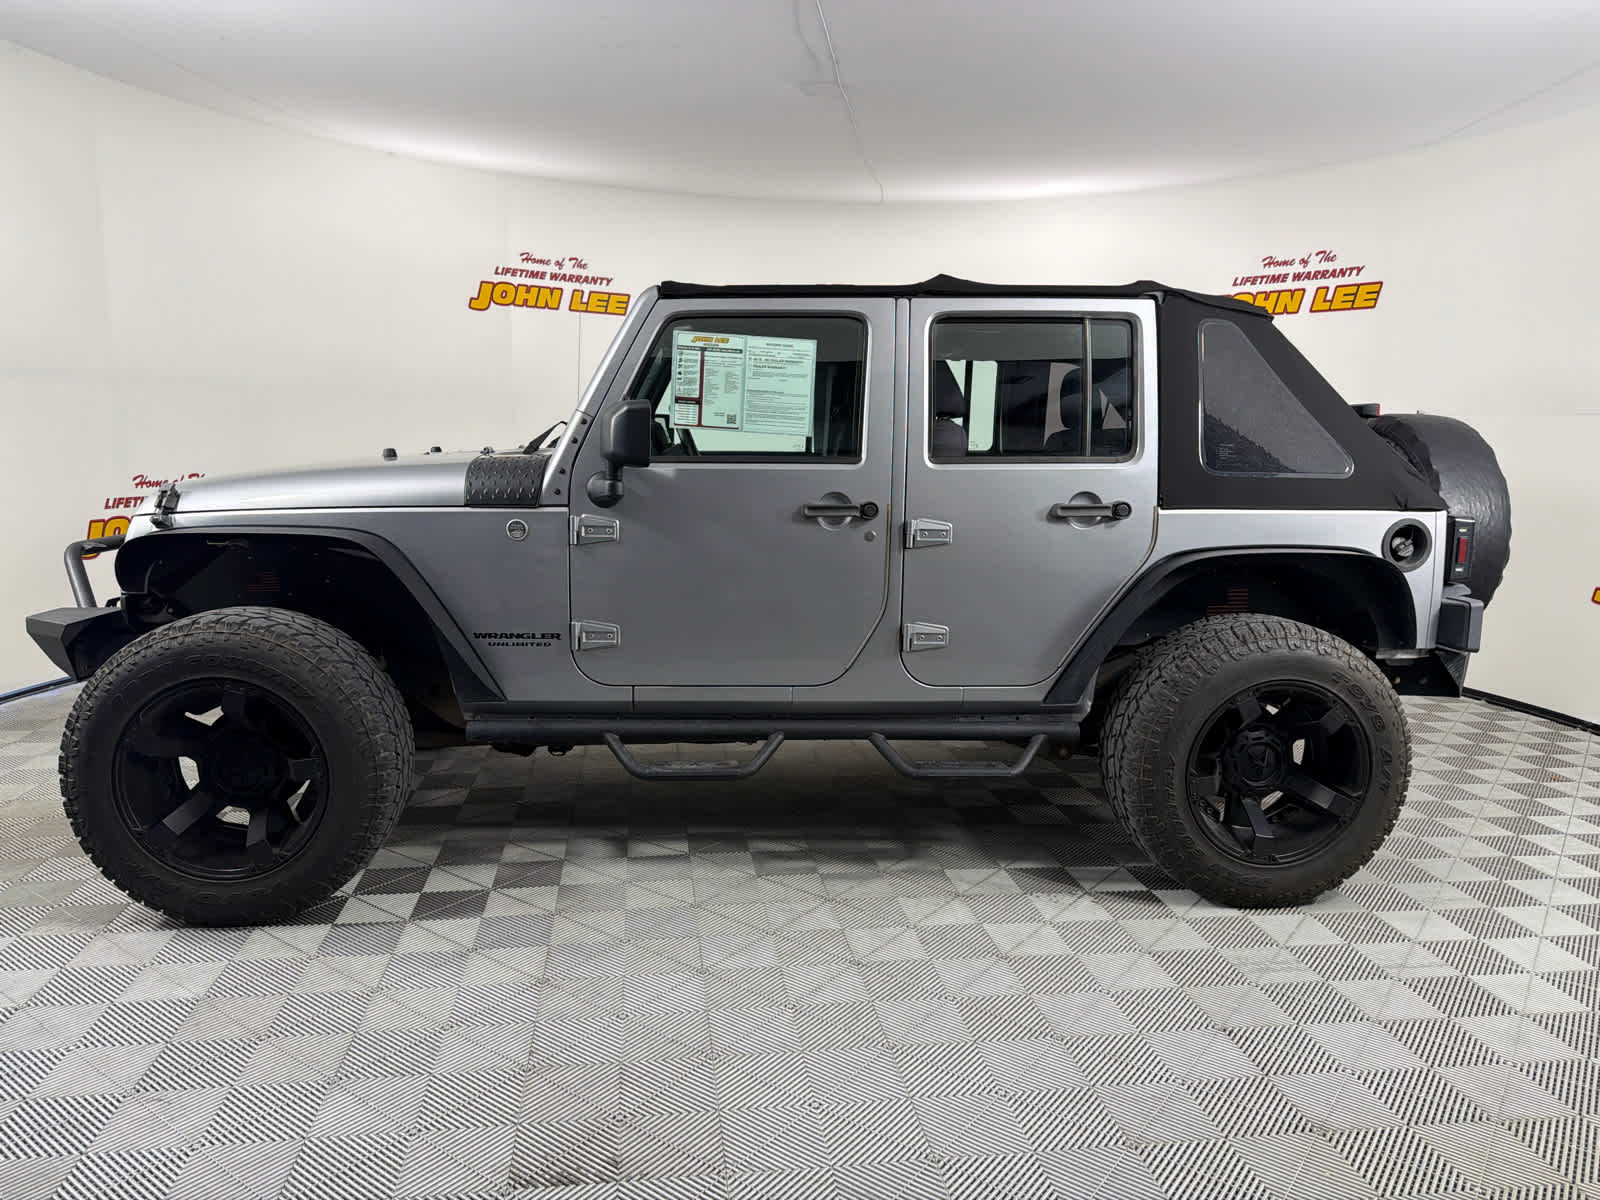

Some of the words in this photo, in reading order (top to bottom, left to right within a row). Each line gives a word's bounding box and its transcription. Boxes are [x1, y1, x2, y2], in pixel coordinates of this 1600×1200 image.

[520, 252, 552, 266] Home
[554, 257, 566, 270] of
[568, 257, 588, 270] The
[1262, 256, 1296, 269] Home
[1299, 253, 1312, 268] of
[1315, 250, 1337, 263] The
[494, 266, 546, 280] LIFETIME
[549, 272, 613, 286] WARRANTY
[1232, 272, 1289, 287] LIFETIME
[1292, 265, 1365, 282] WARRANTY
[469, 281, 563, 311] JOHN
[569, 289, 631, 316] LEE
[1310, 281, 1383, 313] LEE
[473, 632, 561, 641] WRANGLER
